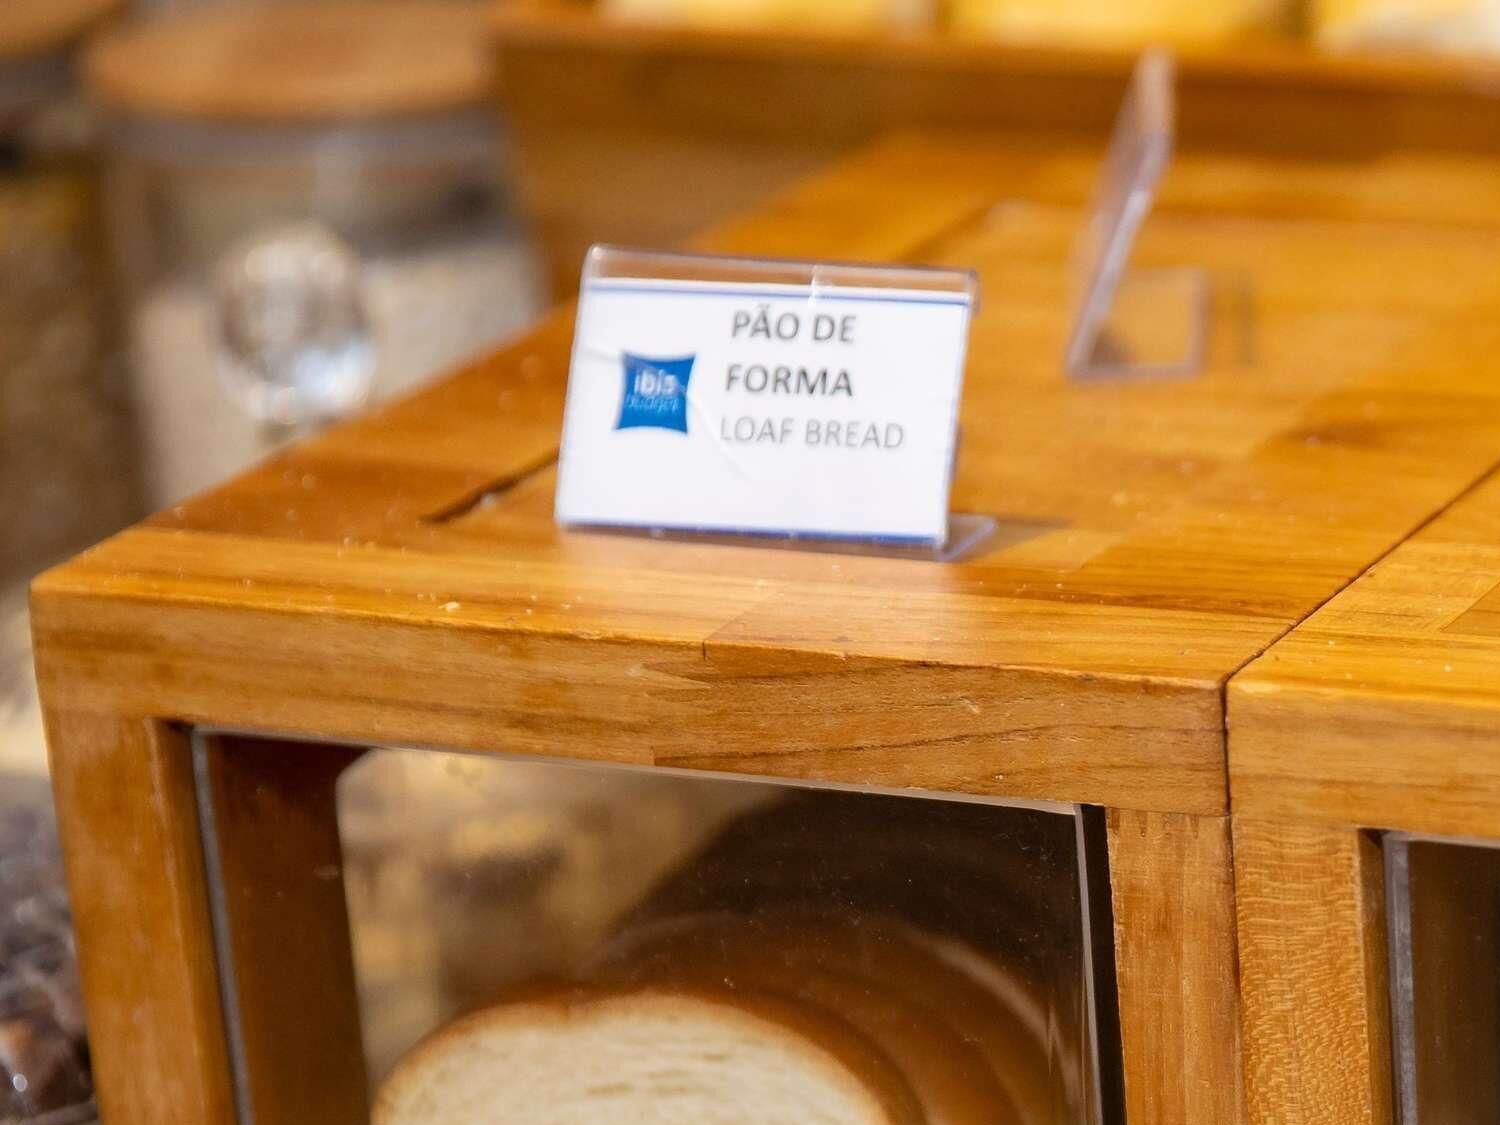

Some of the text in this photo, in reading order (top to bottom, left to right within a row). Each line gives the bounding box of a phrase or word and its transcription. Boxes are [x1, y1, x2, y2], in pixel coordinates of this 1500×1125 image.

[731, 303, 857, 344] PÃO DE
[634, 369, 678, 395] ibis
[725, 362, 854, 398] FORMA
[719, 414, 905, 450] LOAF BREAD
